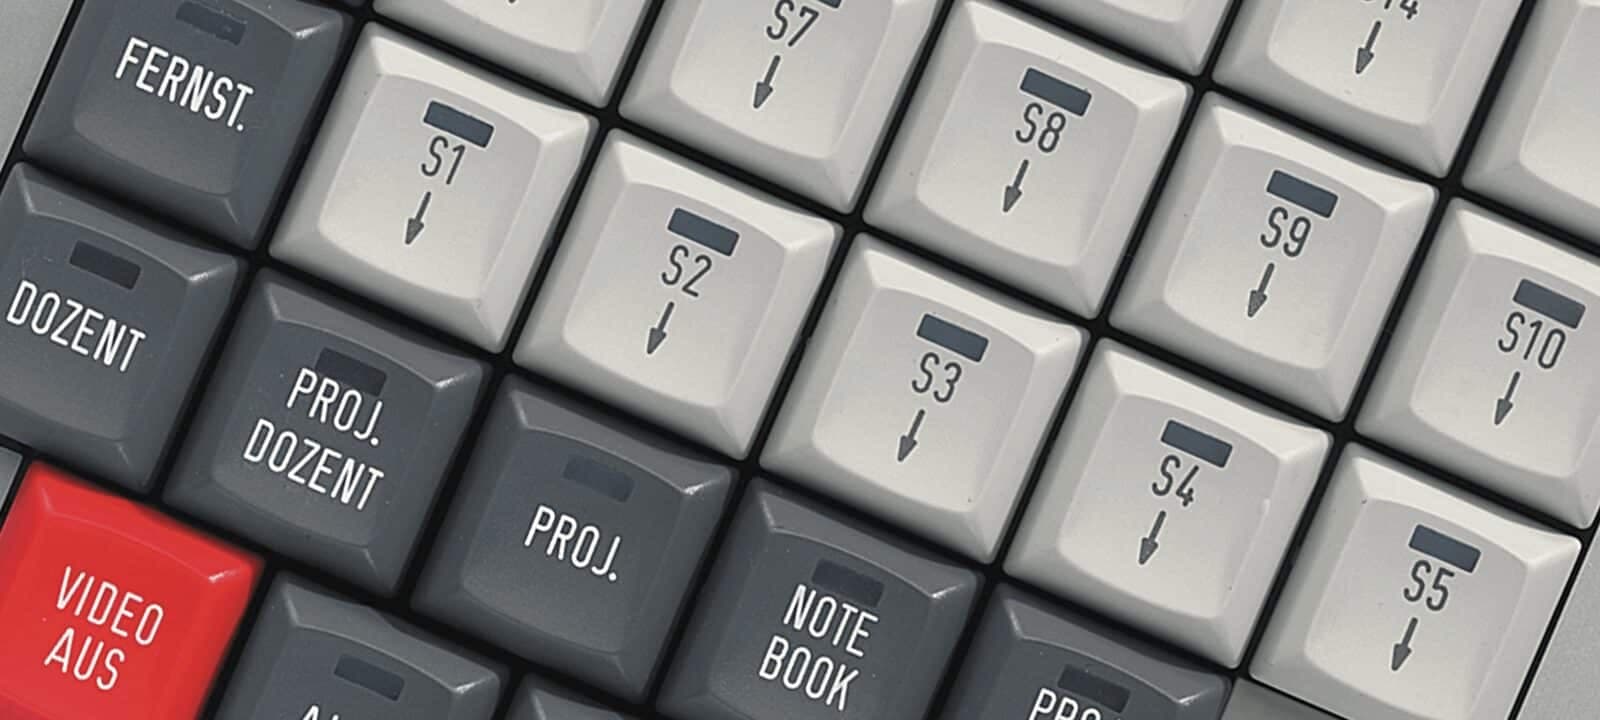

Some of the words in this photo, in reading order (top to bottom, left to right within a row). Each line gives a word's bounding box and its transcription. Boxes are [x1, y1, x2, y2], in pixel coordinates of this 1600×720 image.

[766, 0, 819, 47] S7
[114, 36, 254, 132] FERNST.
[1015, 102, 1067, 153] S8
[420, 136, 466, 185] S1
[1260, 206, 1312, 258] S9
[660, 244, 712, 298] S2
[6, 280, 146, 372] DOZENT
[1498, 312, 1566, 370] S10
[911, 352, 962, 402] S3
[286, 368, 384, 447] PROJ.
[243, 418, 384, 511] DOZENT
[1151, 455, 1199, 508] S4
[524, 505, 620, 582] PROJ.
[56, 566, 164, 646] VIDEO
[1403, 559, 1456, 612] S5
[783, 584, 879, 657] NOTE
[44, 628, 126, 691] AUS
[759, 635, 860, 711] BOOK
